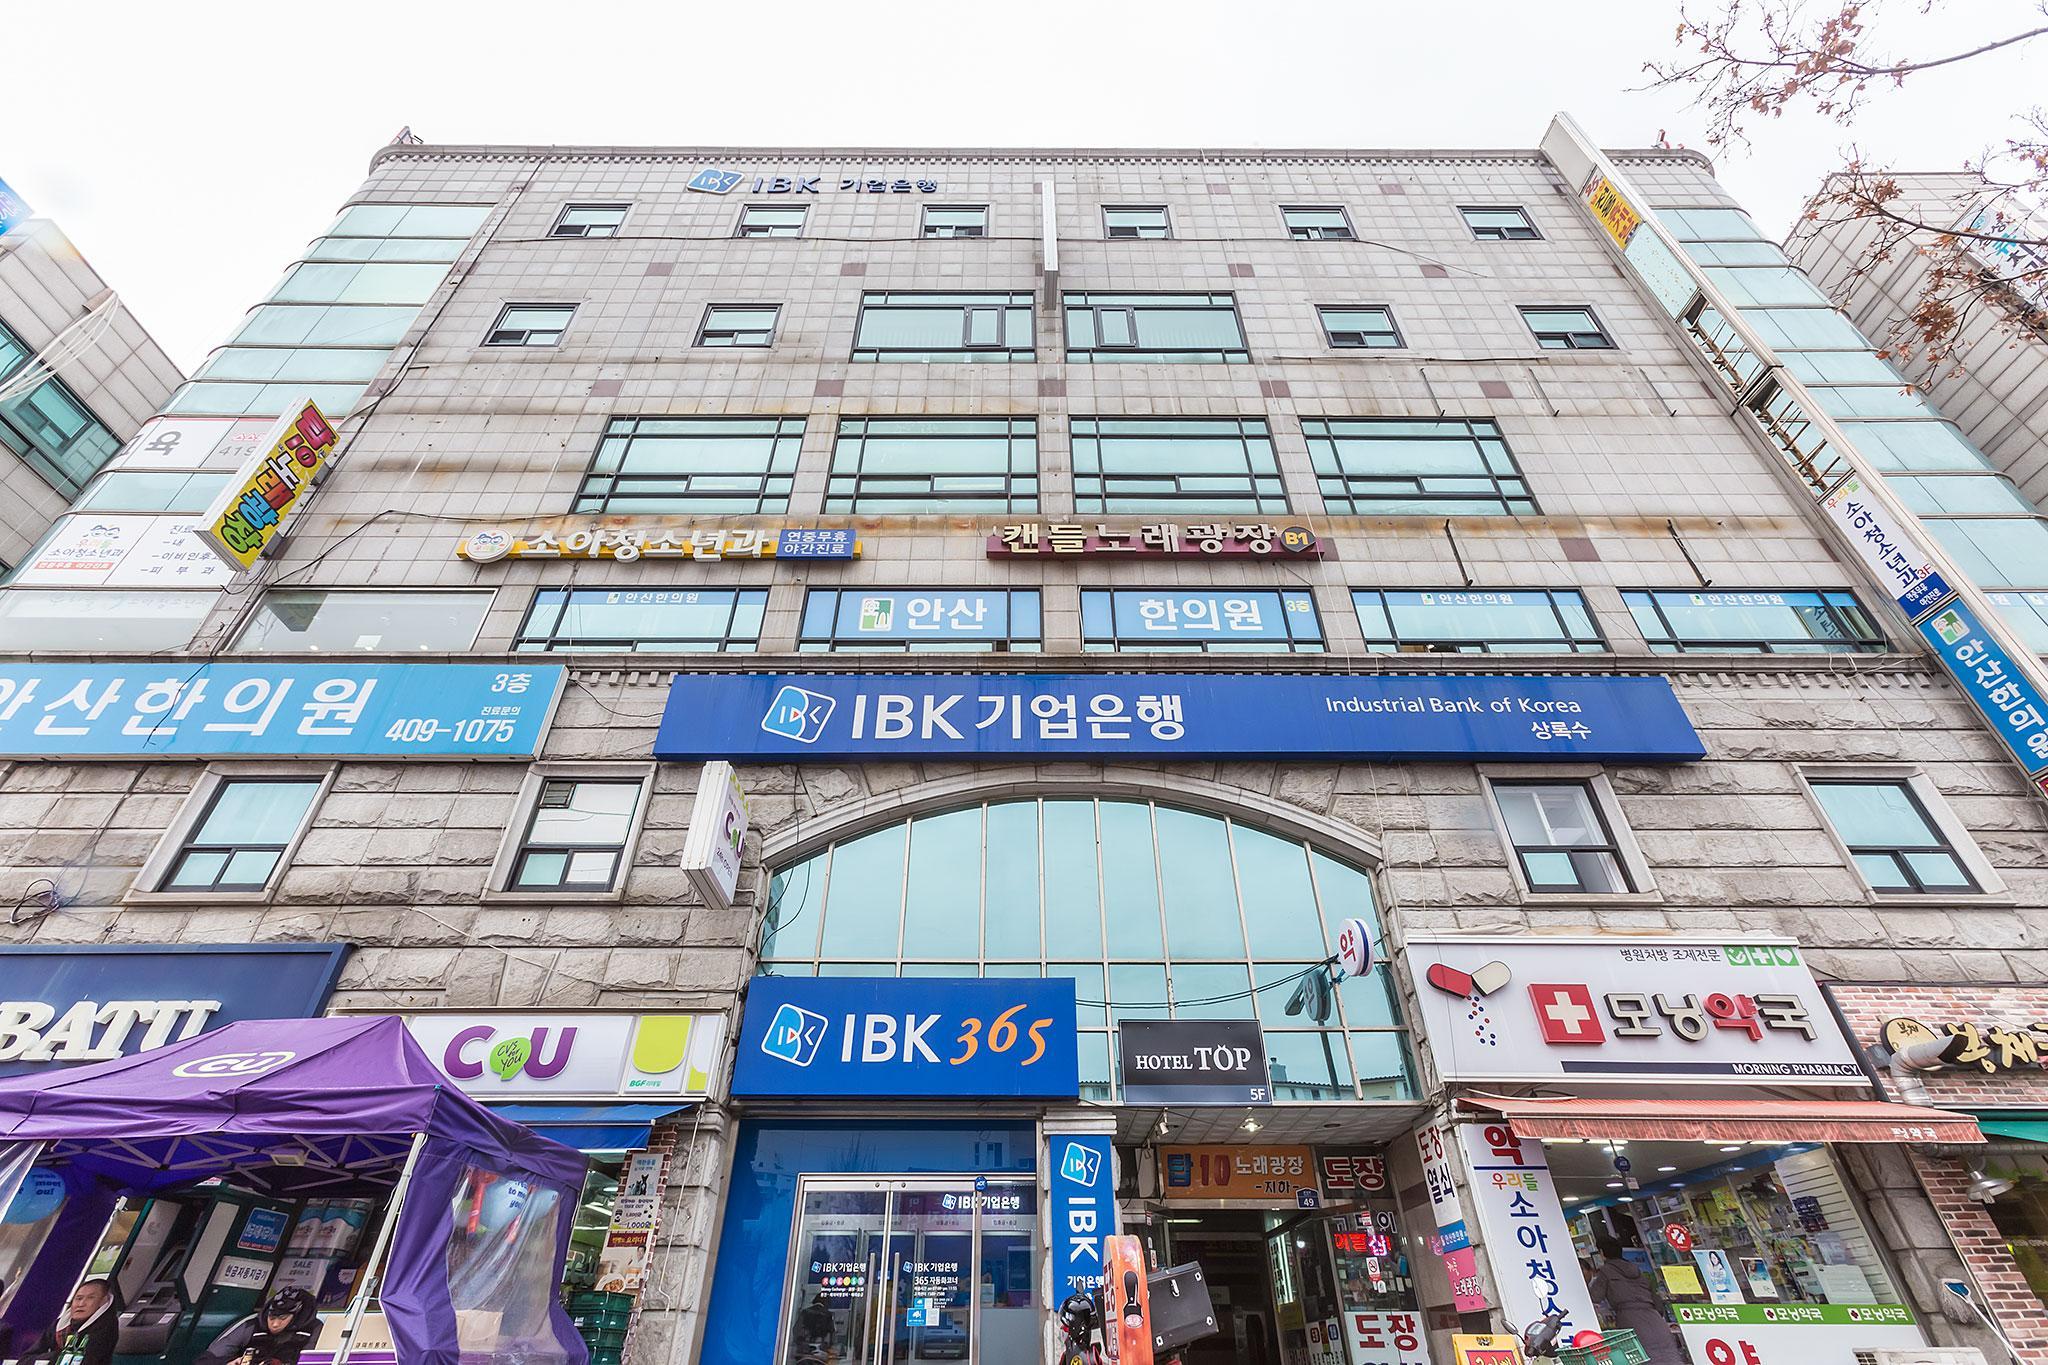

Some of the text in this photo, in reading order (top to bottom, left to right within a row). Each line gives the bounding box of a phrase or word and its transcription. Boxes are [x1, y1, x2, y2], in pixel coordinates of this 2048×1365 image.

[752, 177, 938, 193] IBK 기업은행
[296, 404, 338, 451] 탑
[221, 450, 301, 554] 노래광장
[786, 530, 846, 542] 연중무휴
[1002, 523, 1309, 555] 캔들노래광장 B1
[48, 548, 124, 558] 소아청소년과
[521, 529, 769, 562] 소아청소년과
[784, 543, 845, 555] 야간진료
[1846, 502, 1920, 588] 소아청소년과
[1917, 563, 1931, 579] 3F
[624, 592, 699, 603] 안산한의원
[1439, 592, 1515, 605] 안산한의원
[1707, 593, 1785, 606] 안산한의원
[906, 598, 1310, 631] 안산 한의원 3층
[491, 673, 533, 694] 3층
[481, 706, 521, 716] 진료문의
[1325, 697, 1582, 713] Industrial Bank of Korea
[851, 694, 1186, 741] IBK 기업은행
[385, 718, 516, 743] 409-1075
[1531, 720, 1592, 740] 상록수
[1340, 928, 1357, 962] 약
[1619, 948, 1721, 962] 병원처방 조제전문
[1603, 993, 1819, 1042] 모닝약국
[841, 1003, 1053, 1066] IBK 365
[444, 1025, 578, 1079] CU
[501, 1054, 523, 1071] YOU
[1135, 1054, 1193, 1071] HOTEL
[1732, 1063, 1859, 1076] MORNING PHARMACY
[1250, 1088, 1265, 1100] 5F
[1418, 1124, 1443, 1164] 도장
[1483, 1125, 1522, 1166] 약
[1167, 1153, 1304, 1187] 탑 10 노래광장
[1323, 1156, 1385, 1191] 도장
[1491, 1172, 1539, 1192] 우리들
[981, 1195, 1020, 1210] 기업은행
[1303, 1198, 1315, 1208] 49
[1067, 1197, 1099, 1263] IBK
[225, 1264, 268, 1281] 현금자동지급기
[293, 1260, 313, 1268] SALE
[822, 1262, 866, 1272] IBK 기업은행
[914, 1262, 957, 1272] IBK 기업은행
[1510, 1193, 1574, 1343] 소아청소
[914, 1276, 929, 1285] 365
[1692, 1307, 1740, 1320] 모닝약국
[1777, 1307, 1824, 1321] 모닝약국
[1860, 1307, 1908, 1321] 모닝약국
[1355, 1314, 1418, 1351] 도장
